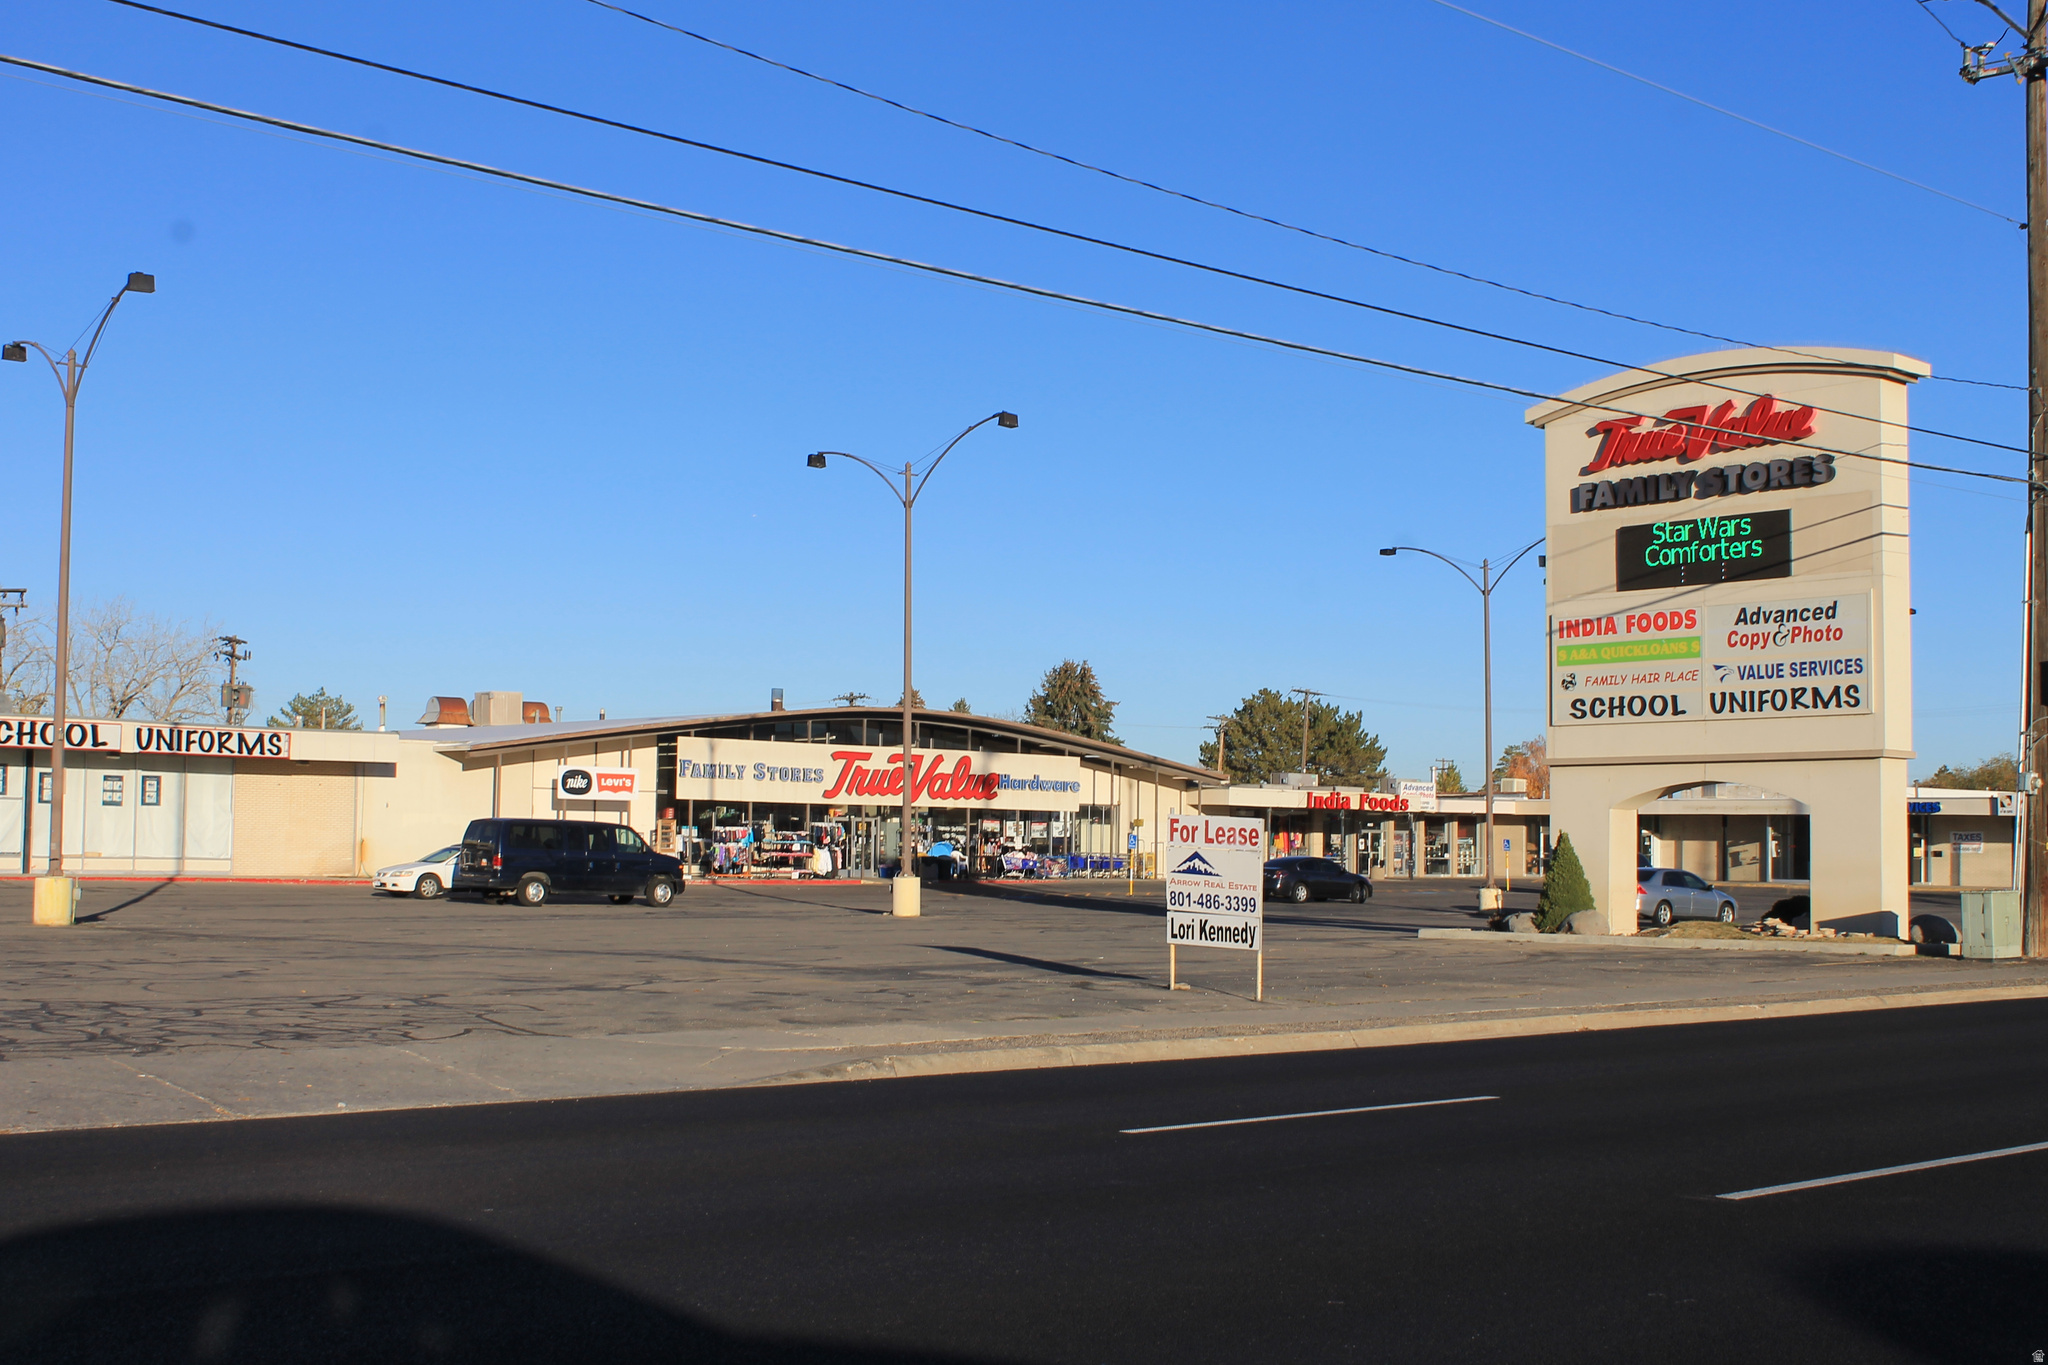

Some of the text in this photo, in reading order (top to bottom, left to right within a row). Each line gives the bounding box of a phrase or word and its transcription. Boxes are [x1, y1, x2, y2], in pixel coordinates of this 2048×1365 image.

[1580, 393, 1818, 475] True Value
[1571, 454, 1836, 513] FAMILY STORES
[1652, 516, 1751, 544] Star Wars
[1645, 538, 1763, 567] Comforters
[1558, 609, 1697, 639] INDIA FOODS
[1734, 600, 1838, 626] Advanced
[1570, 648, 1599, 661] A&A
[1601, 642, 1688, 659] QUICKLOANS
[1584, 669, 1699, 687] FAMILY HAIR PLACE
[1737, 658, 1863, 681] VALUE SERVICES
[1569, 694, 1687, 719] SCHOOL
[1709, 684, 1860, 714] UNIFORMS
[136, 727, 282, 756] UNIFORMS
[566, 775, 589, 789] nike
[822, 751, 998, 803] True Value
[998, 774, 1081, 793] Hardware
[1403, 784, 1434, 792] Advanced
[1307, 791, 1409, 811] India Foods
[1169, 818, 1259, 847] For Lease
[1953, 832, 1982, 841] TAXES
[1169, 878, 1257, 892] ARROW REAL ESTATE
[1169, 890, 1257, 913] 801-486-3399
[1170, 917, 1257, 948] Lori Kennedy
